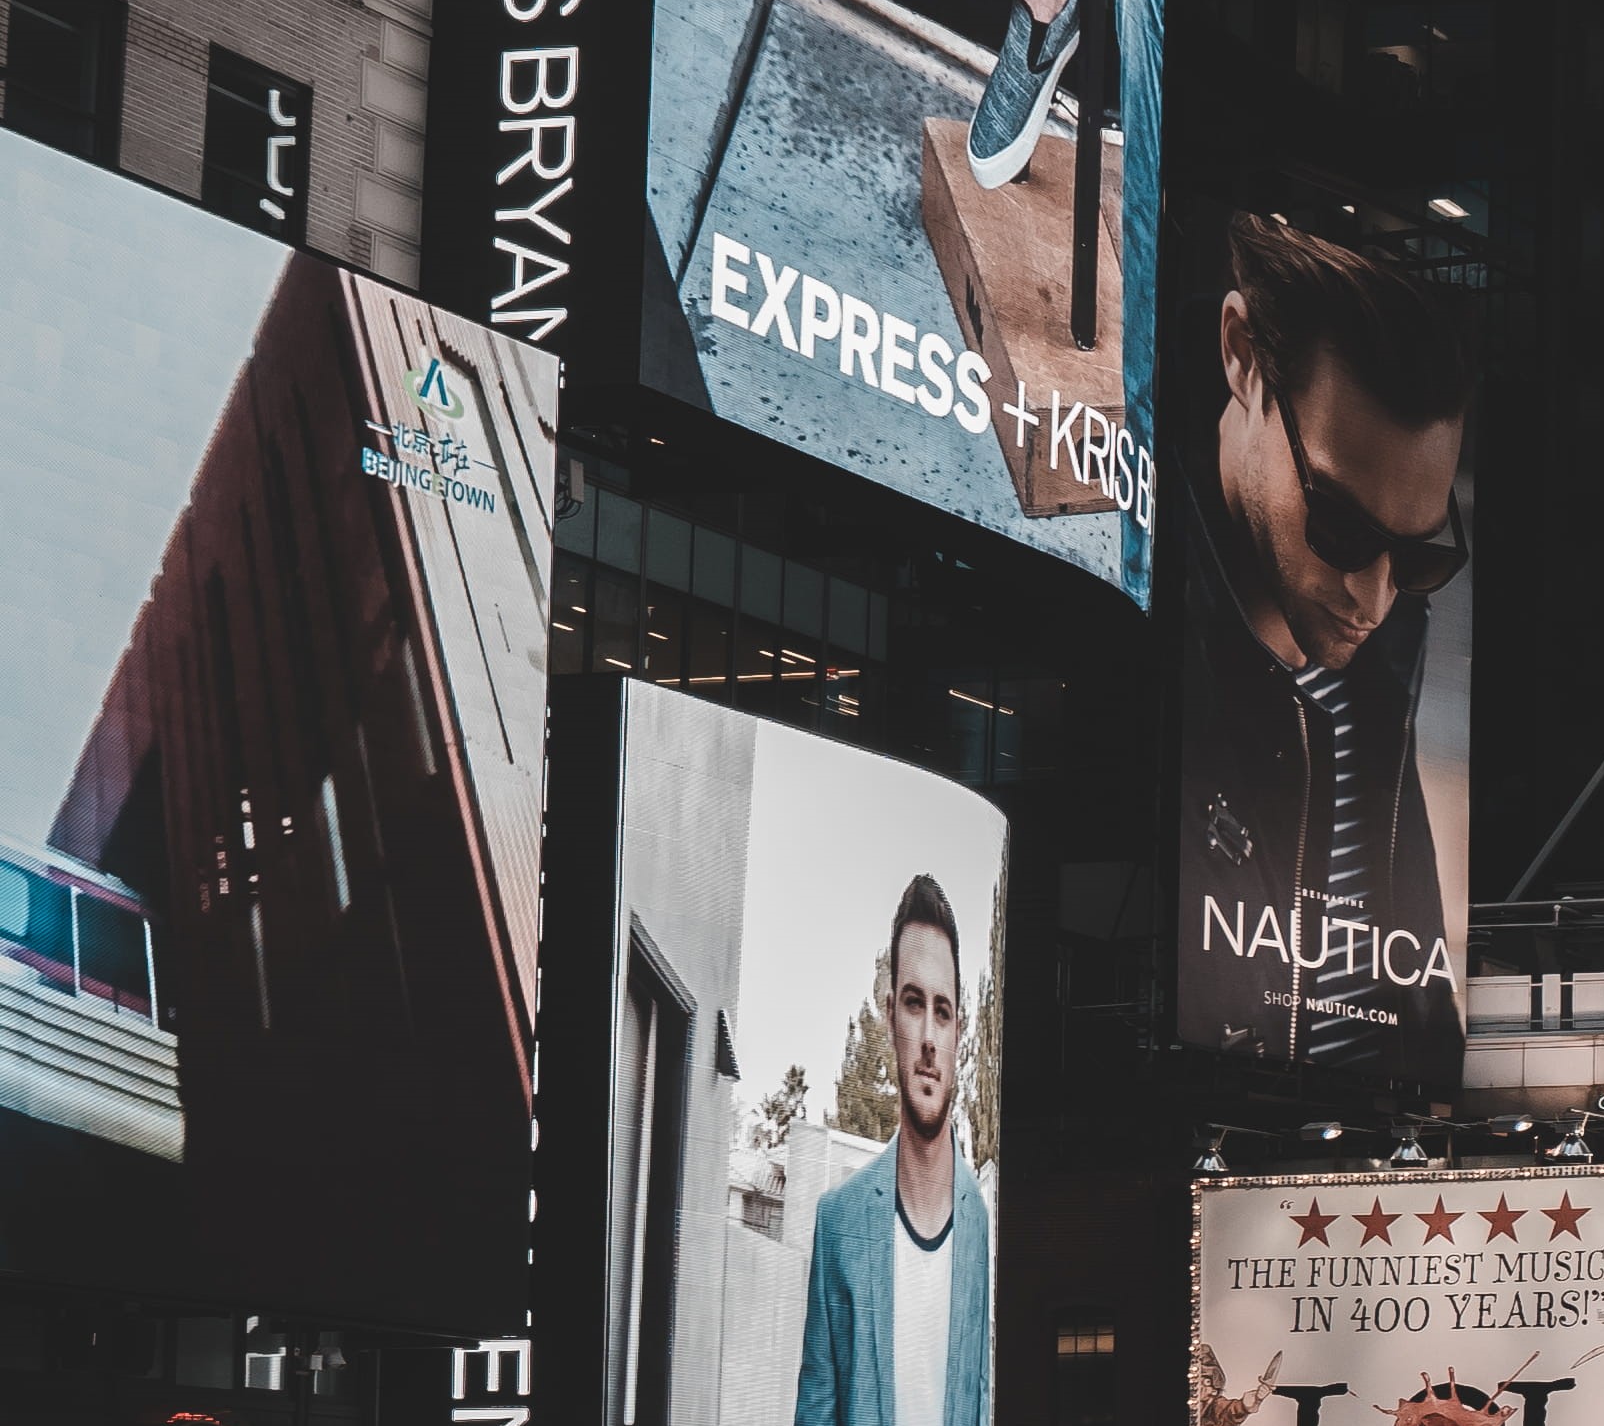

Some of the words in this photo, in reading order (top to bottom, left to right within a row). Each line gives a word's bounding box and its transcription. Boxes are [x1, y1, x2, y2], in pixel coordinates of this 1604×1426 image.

[709, 231, 993, 435] EXPRESS
[1049, 389, 1134, 511] KRIS
[1201, 894, 1458, 993] NAUTICA
[1264, 990, 1302, 1007] SHOP
[1305, 997, 1398, 1027] NAUTICA.COM
[1227, 1256, 1297, 1291] THE
[1306, 1251, 1485, 1289] FUNNIEST
[1289, 1296, 1333, 1334] IN
[1350, 1295, 1430, 1334] 400
